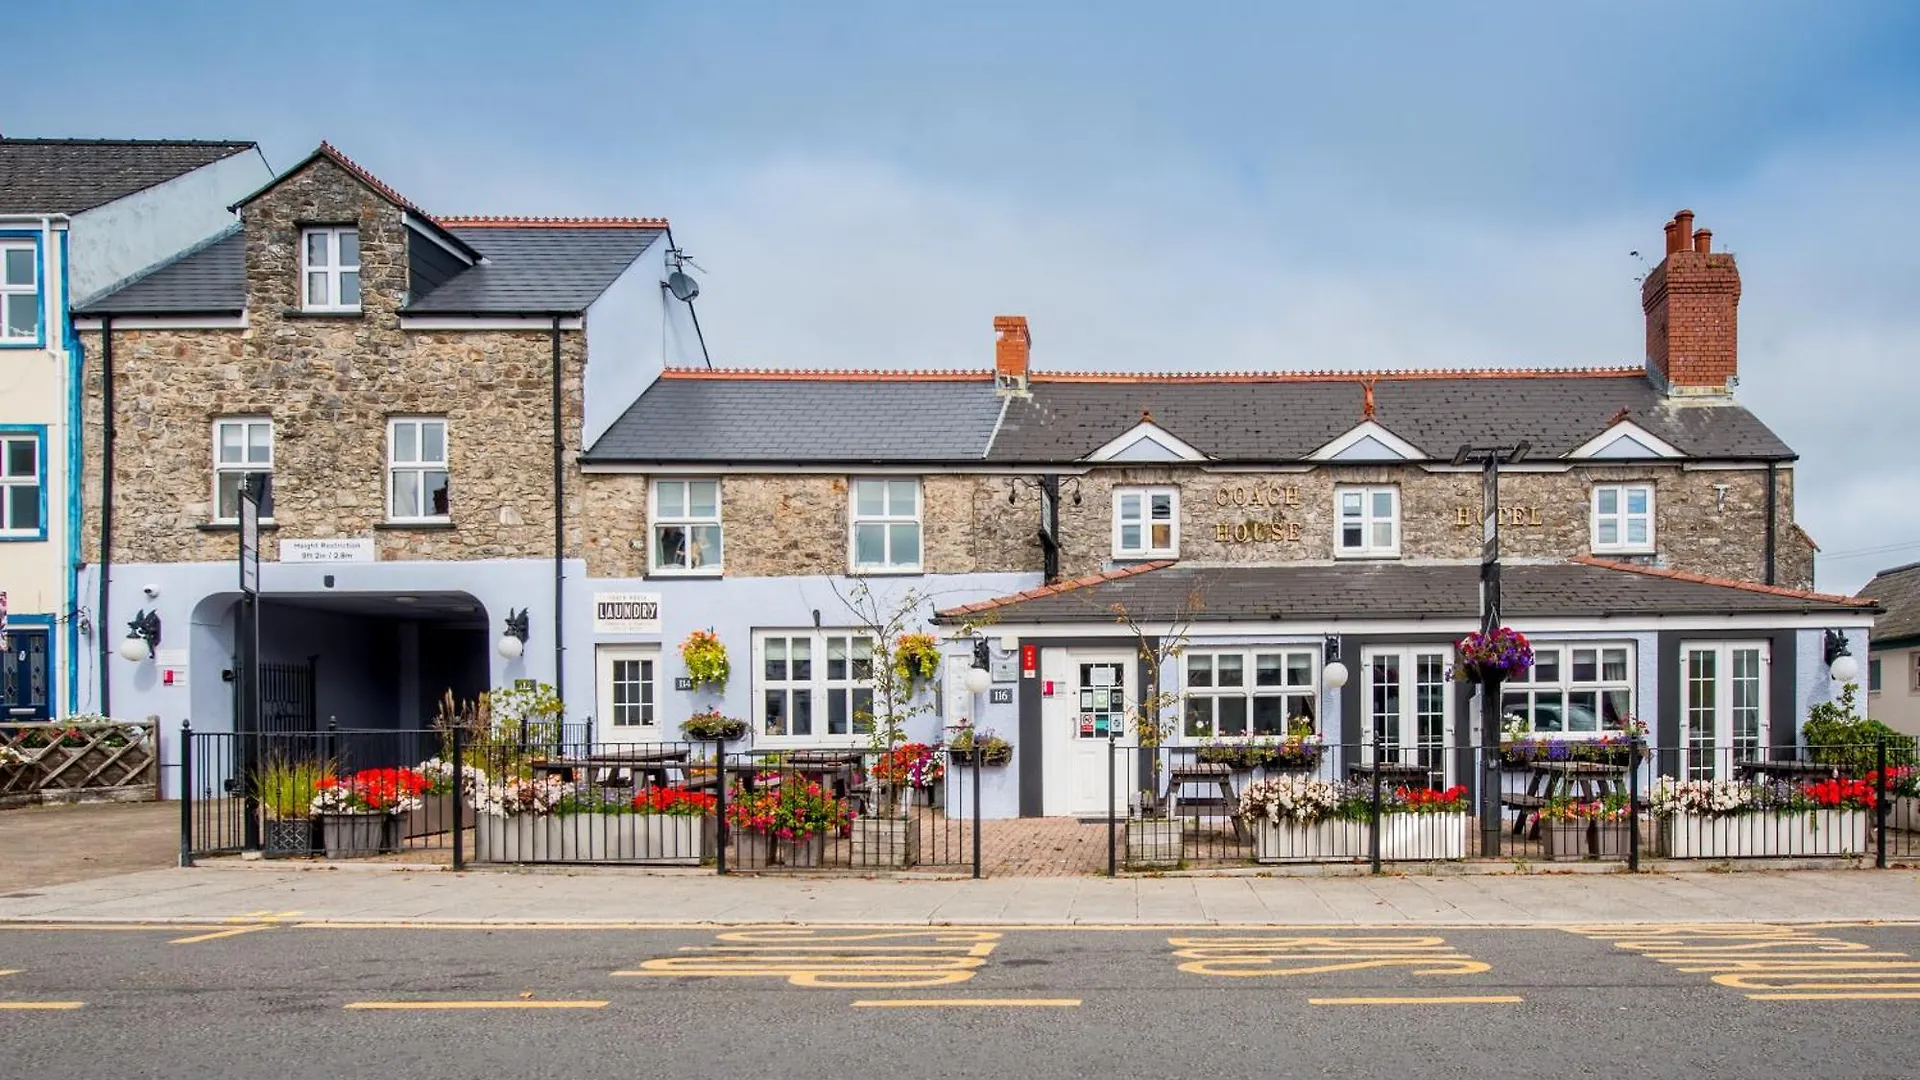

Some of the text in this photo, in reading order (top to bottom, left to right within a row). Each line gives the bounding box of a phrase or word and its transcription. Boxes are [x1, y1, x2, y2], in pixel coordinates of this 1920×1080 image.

[1216, 486, 1300, 507] COACH
[1215, 523, 1300, 542] HOUSE
[293, 542, 318, 550] Height
[598, 602, 657, 619] LAUNDRY
[994, 691, 1008, 701] 116
[608, 930, 1003, 988] STOP
